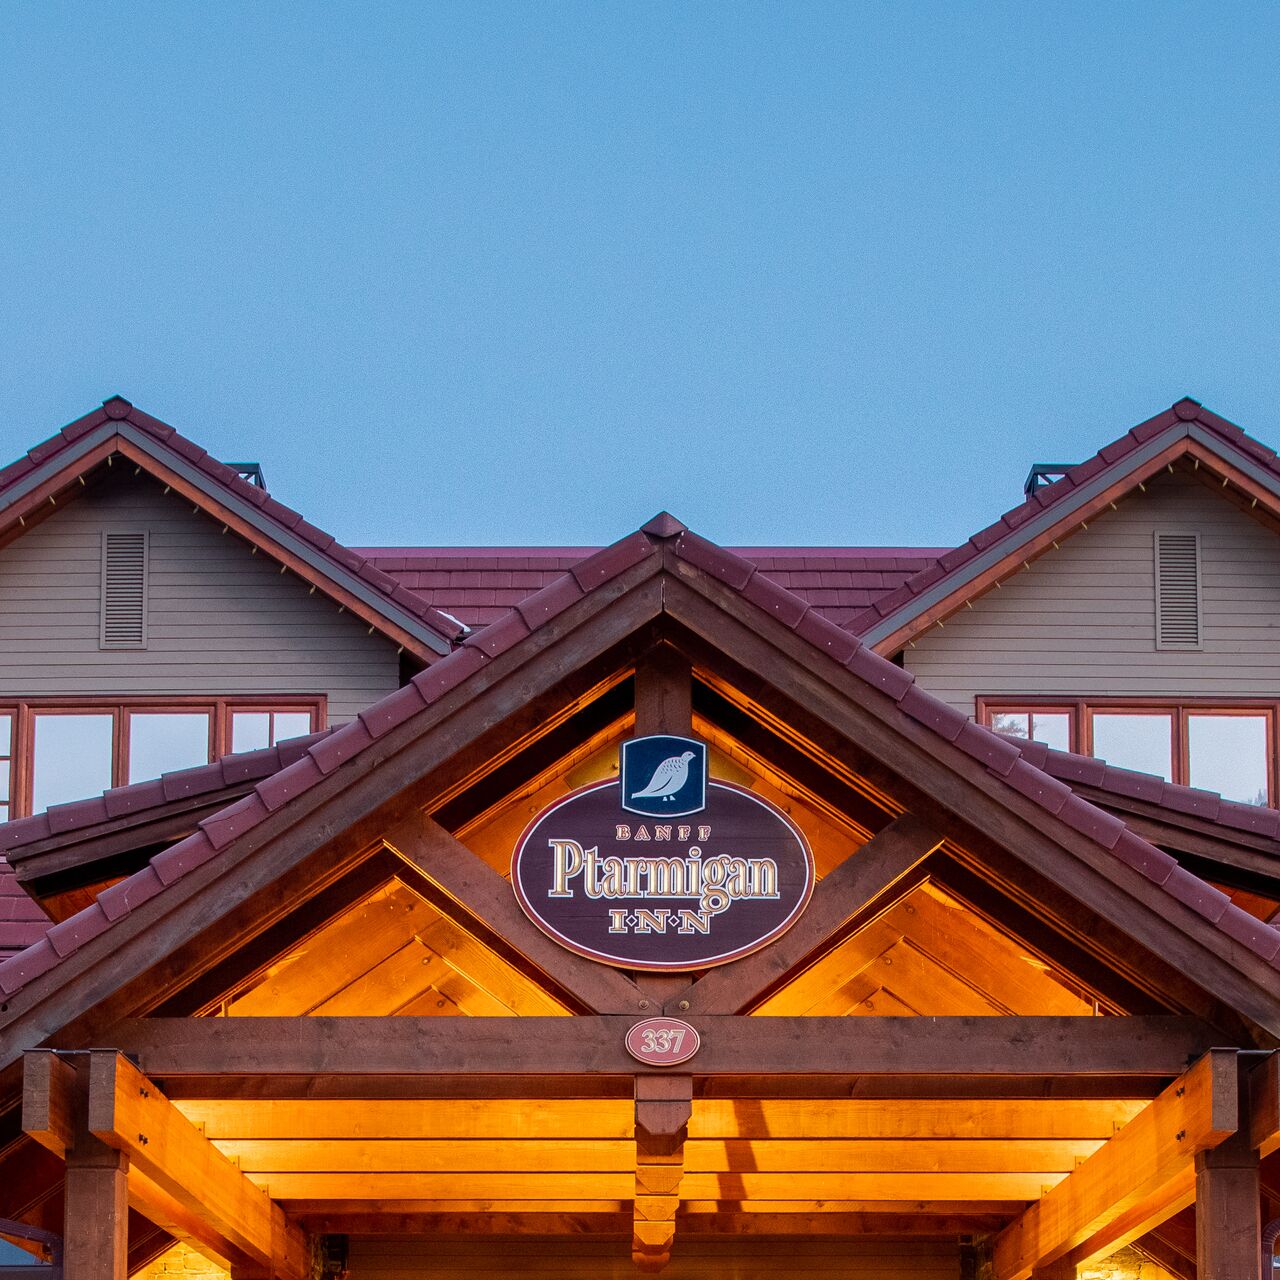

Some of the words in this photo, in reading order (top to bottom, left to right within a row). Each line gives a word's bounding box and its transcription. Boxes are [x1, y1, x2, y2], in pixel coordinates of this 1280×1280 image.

[615, 824, 712, 841] BANFF
[548, 838, 780, 914] Ptarmigan
[640, 1028, 687, 1055] 337
